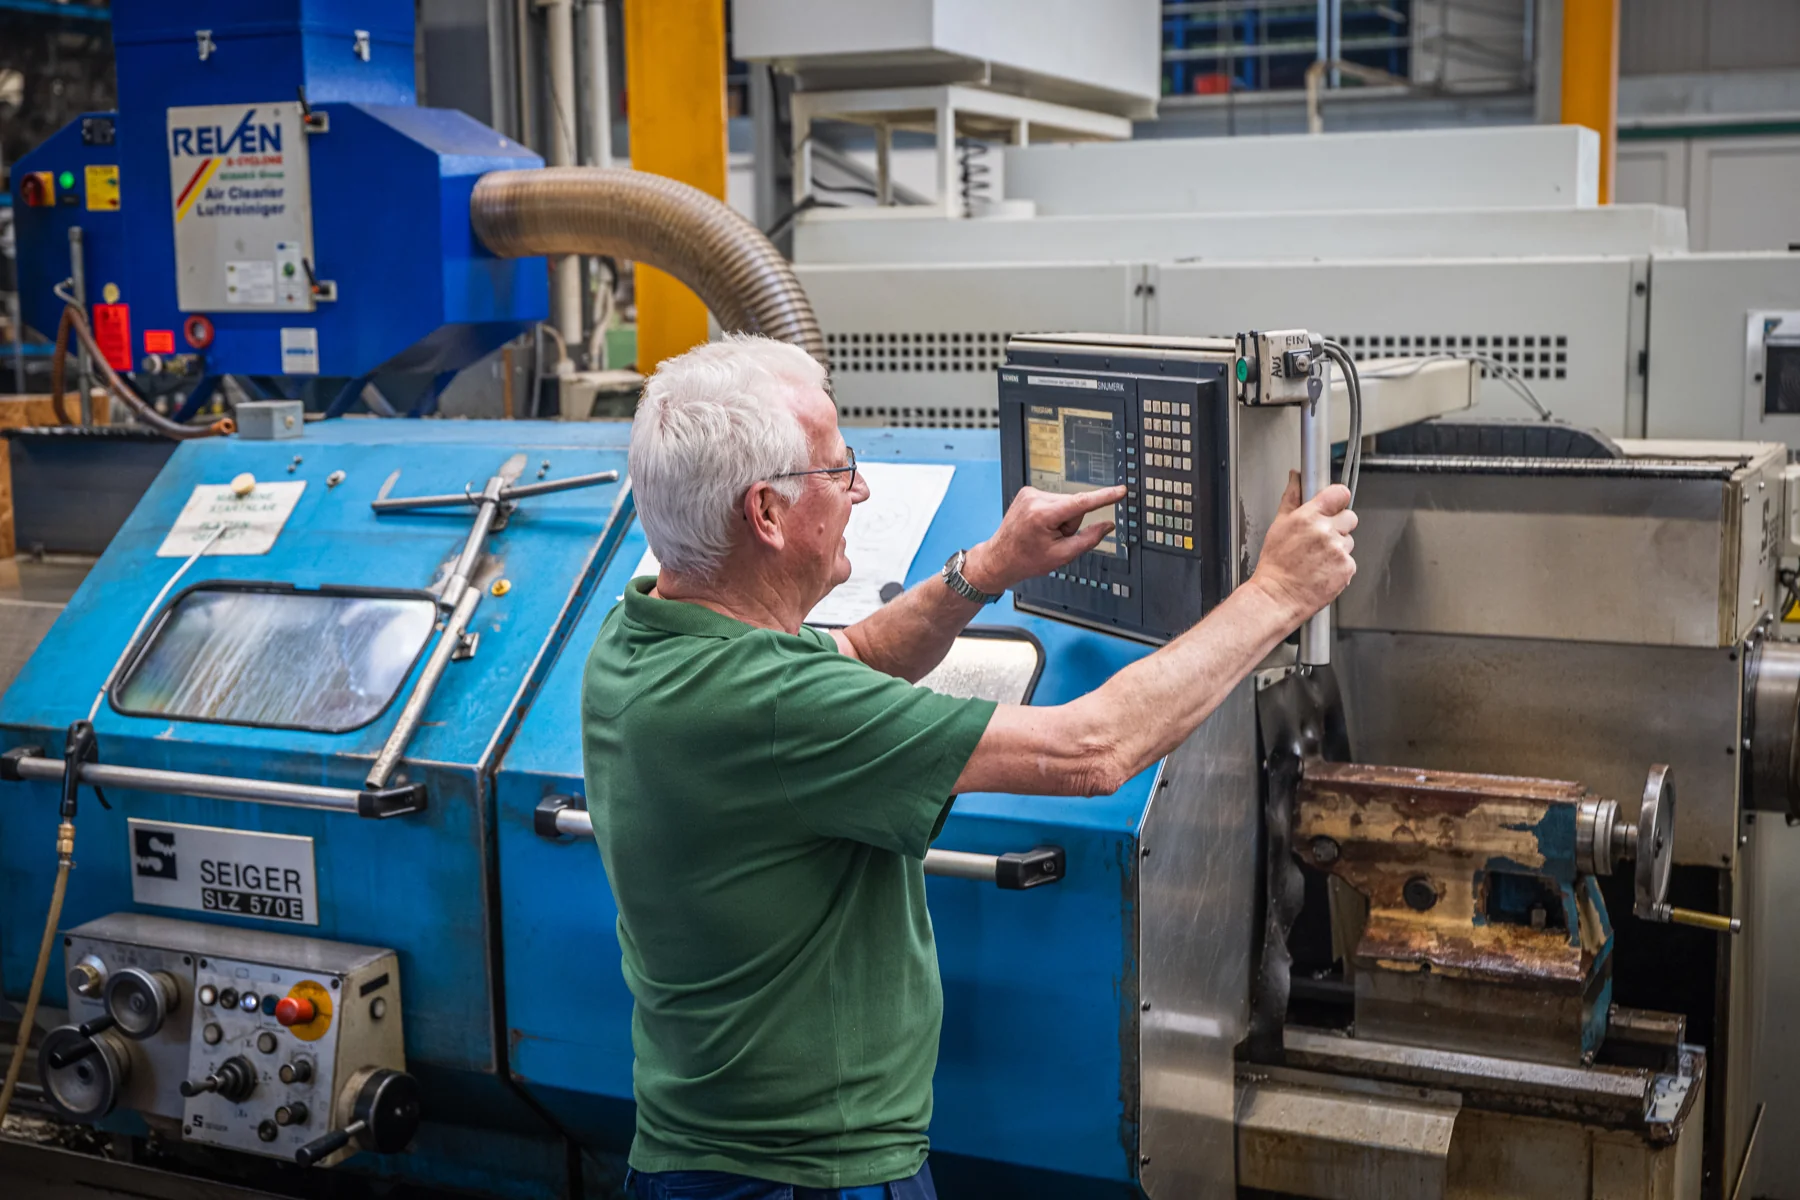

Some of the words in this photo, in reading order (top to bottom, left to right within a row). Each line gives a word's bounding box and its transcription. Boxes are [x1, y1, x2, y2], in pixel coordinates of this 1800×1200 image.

[172, 109, 282, 155] REVEN
[204, 187, 224, 199] Air
[228, 186, 284, 200] Cleaner
[197, 202, 285, 218] Luftreiniger
[1285, 335, 1306, 346] EIN
[200, 858, 302, 894] SEIGER
[203, 888, 241, 911] SLZ
[249, 896, 303, 918] 570E
